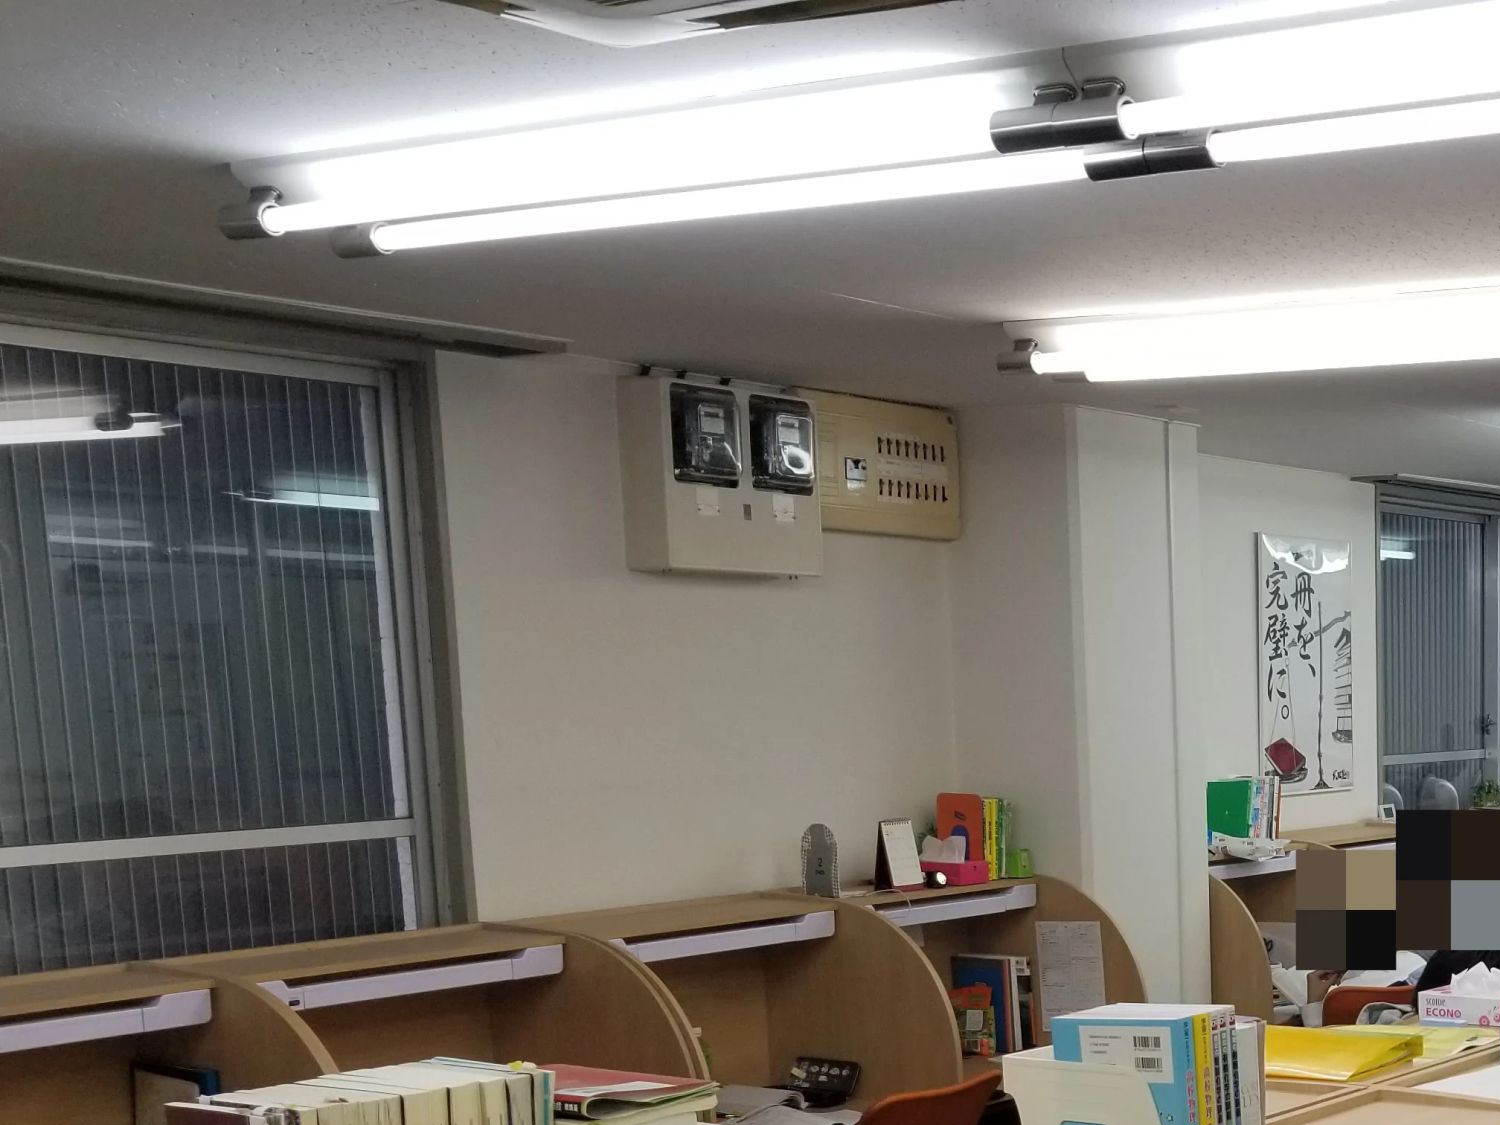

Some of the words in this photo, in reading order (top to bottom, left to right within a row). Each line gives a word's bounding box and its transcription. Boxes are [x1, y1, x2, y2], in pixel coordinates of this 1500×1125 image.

[1264, 561, 1290, 720] 完璧に。
[1290, 551, 1317, 677] 冊を、
[1425, 1007, 1462, 1019] ECONO
